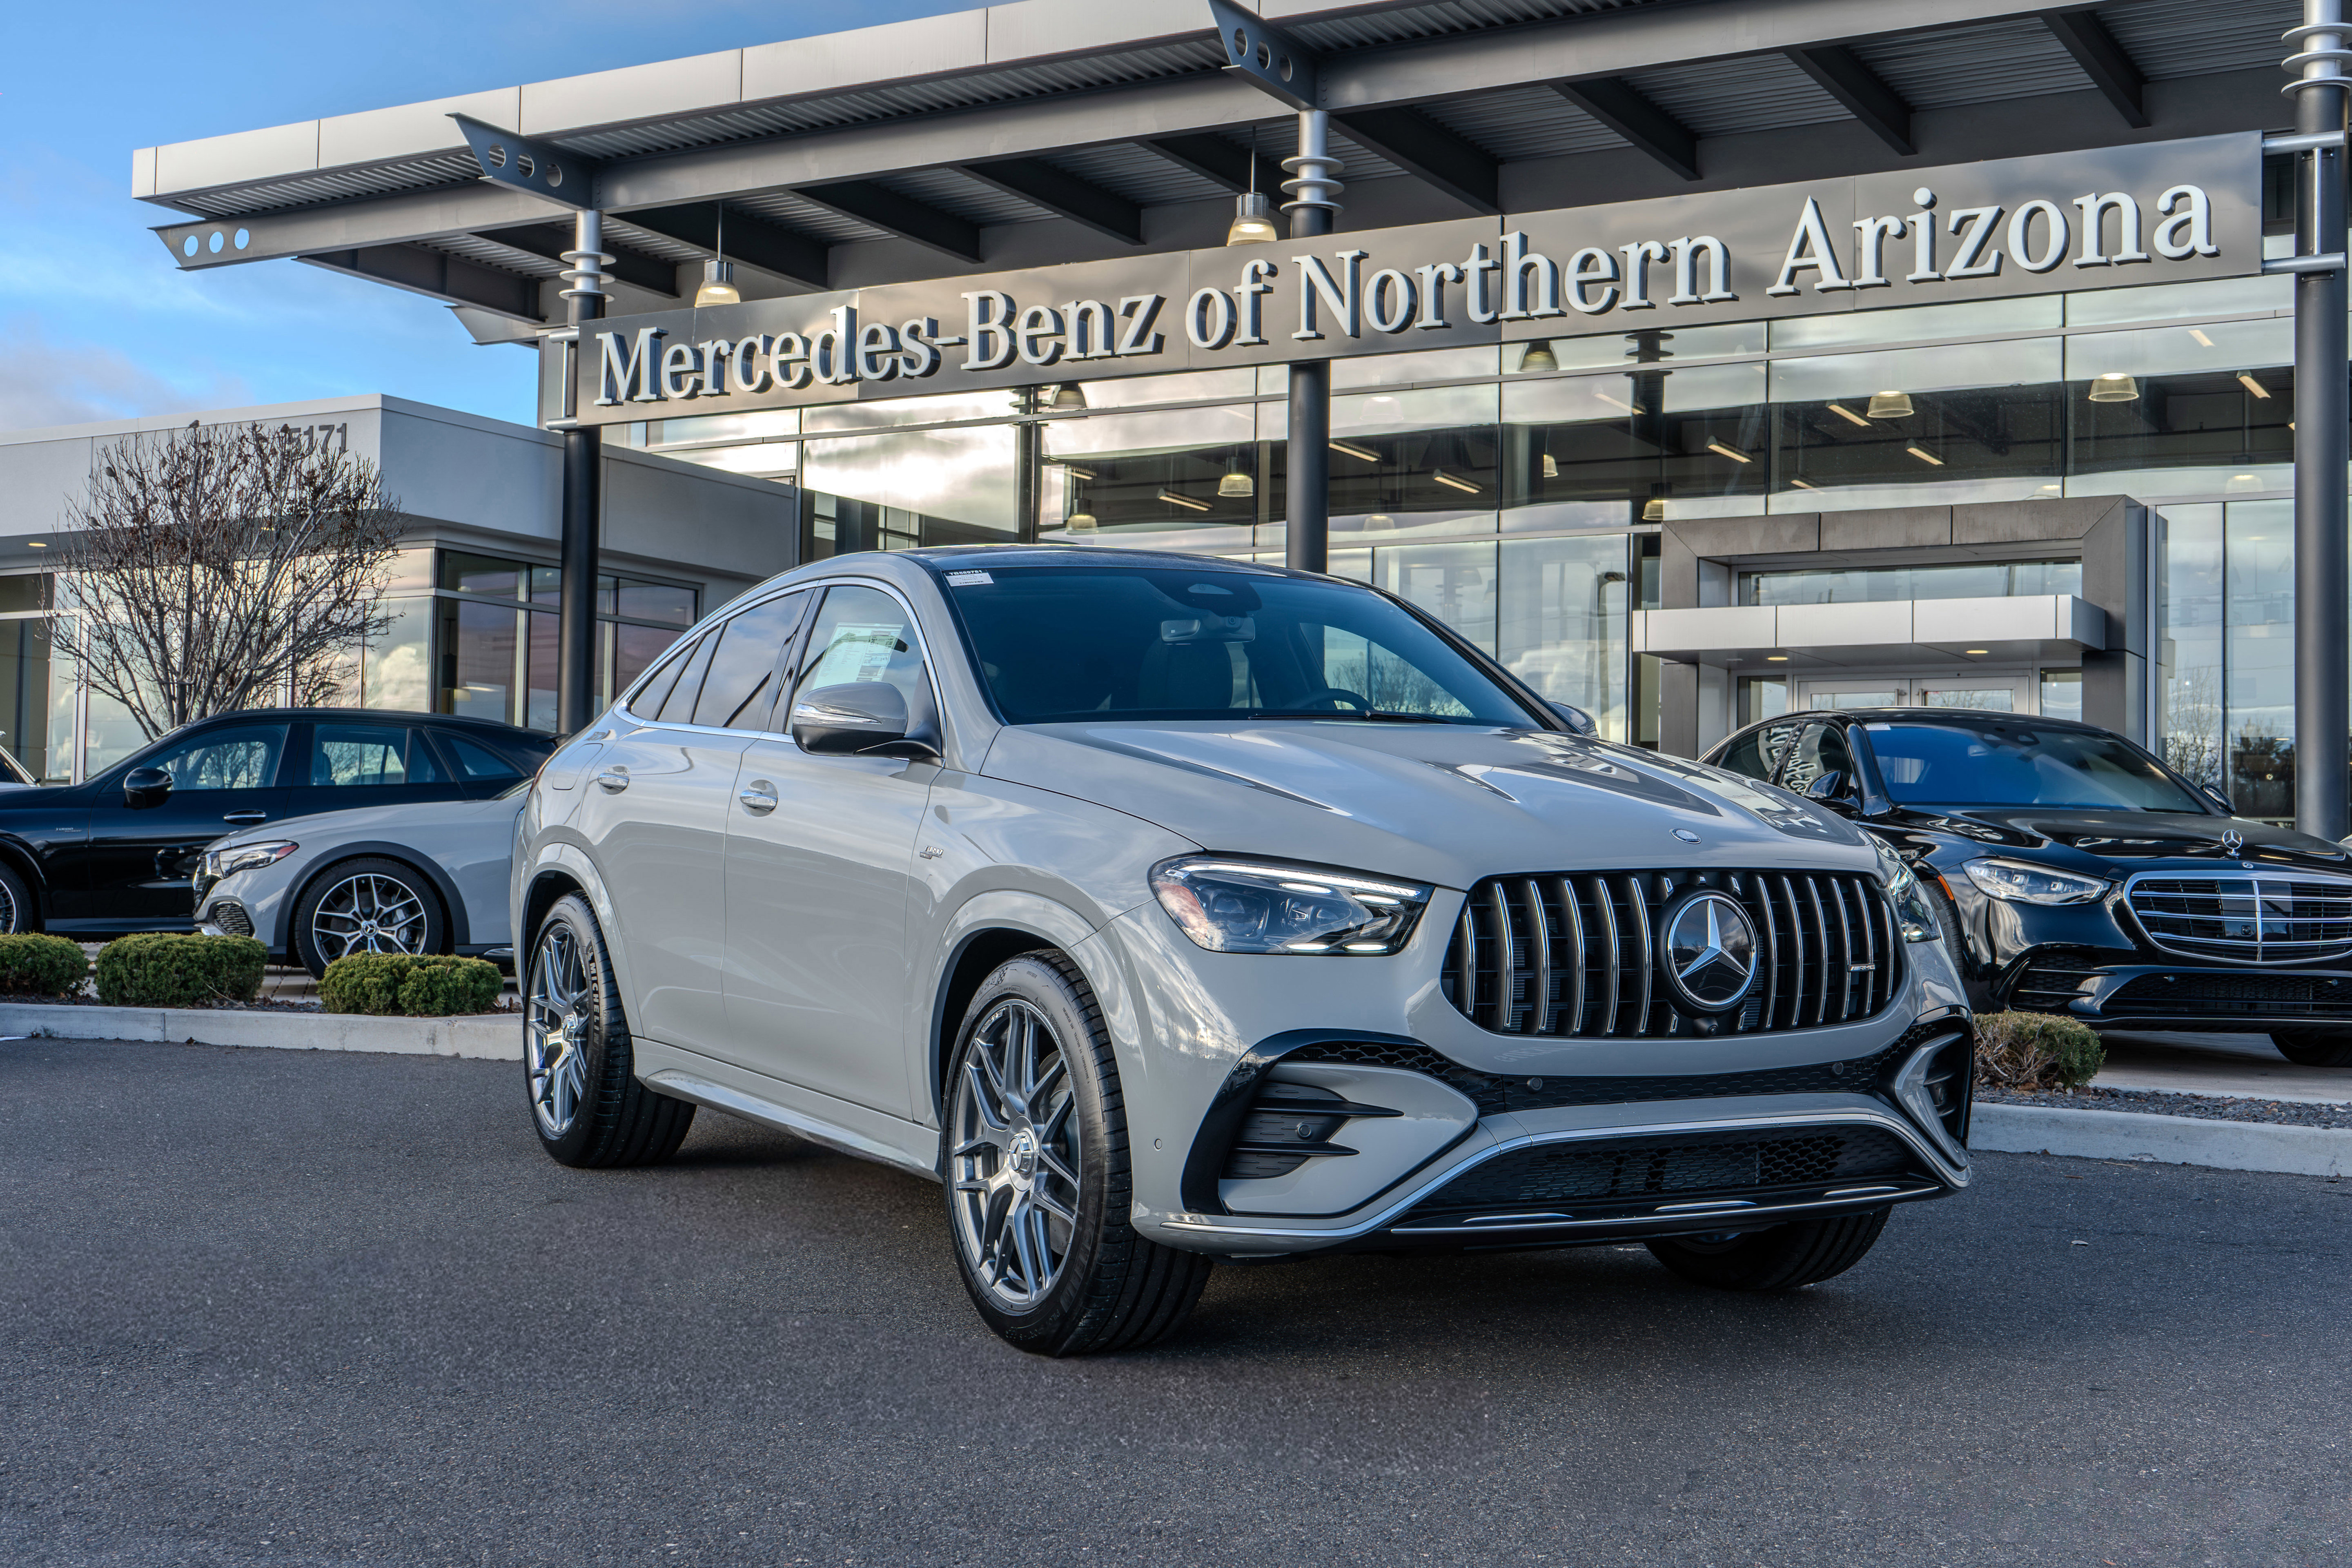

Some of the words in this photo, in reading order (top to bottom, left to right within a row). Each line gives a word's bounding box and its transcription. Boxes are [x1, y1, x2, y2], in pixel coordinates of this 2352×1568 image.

[594, 290, 1166, 405] Mercedes-Benz
[1185, 258, 1277, 350] of
[1292, 230, 1738, 341] Northern
[1766, 184, 2219, 297] Arizona
[925, 845, 943, 855] TURBO
[590, 962, 599, 1044] MICHELIN
